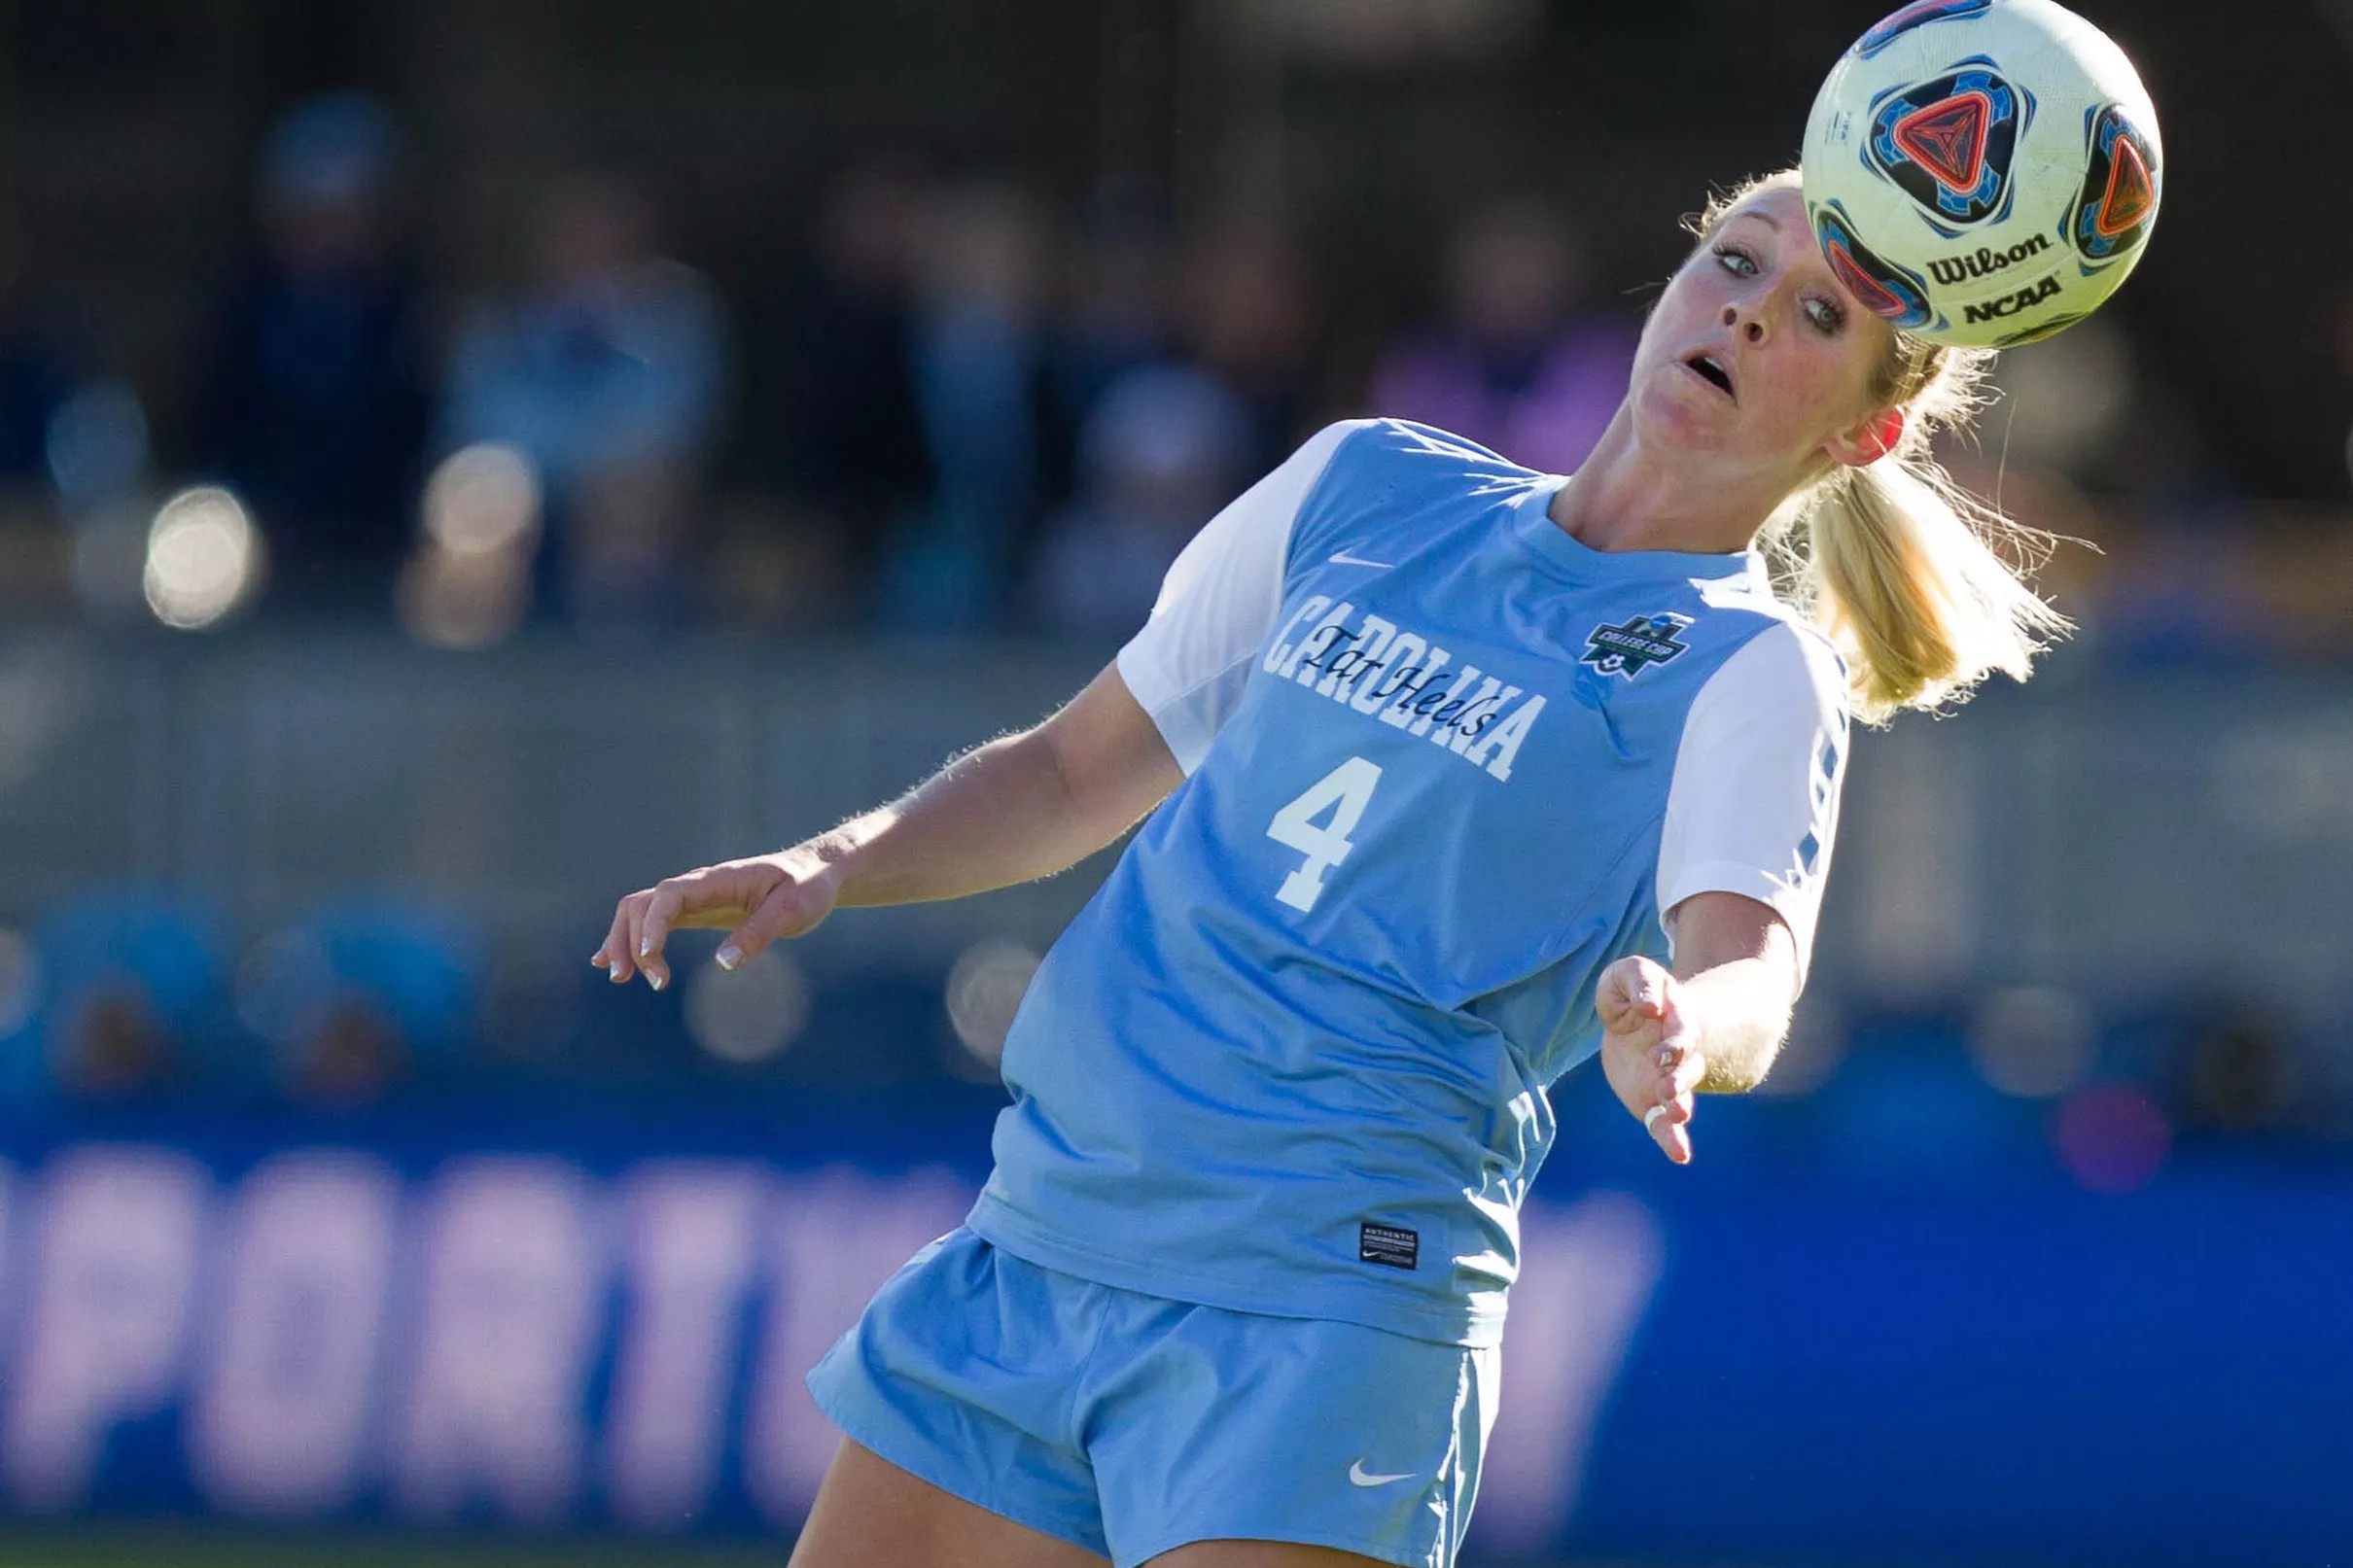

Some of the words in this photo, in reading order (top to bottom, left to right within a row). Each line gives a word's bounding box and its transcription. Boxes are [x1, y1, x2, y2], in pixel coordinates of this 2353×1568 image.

[1926, 232, 2051, 285] Wilson
[1963, 275, 2062, 324] NCAA
[1263, 595, 1548, 782] CAROLINA
[1304, 625, 1384, 683] Tar
[1372, 667, 1498, 736] Heels
[1266, 756, 1383, 912] 4
